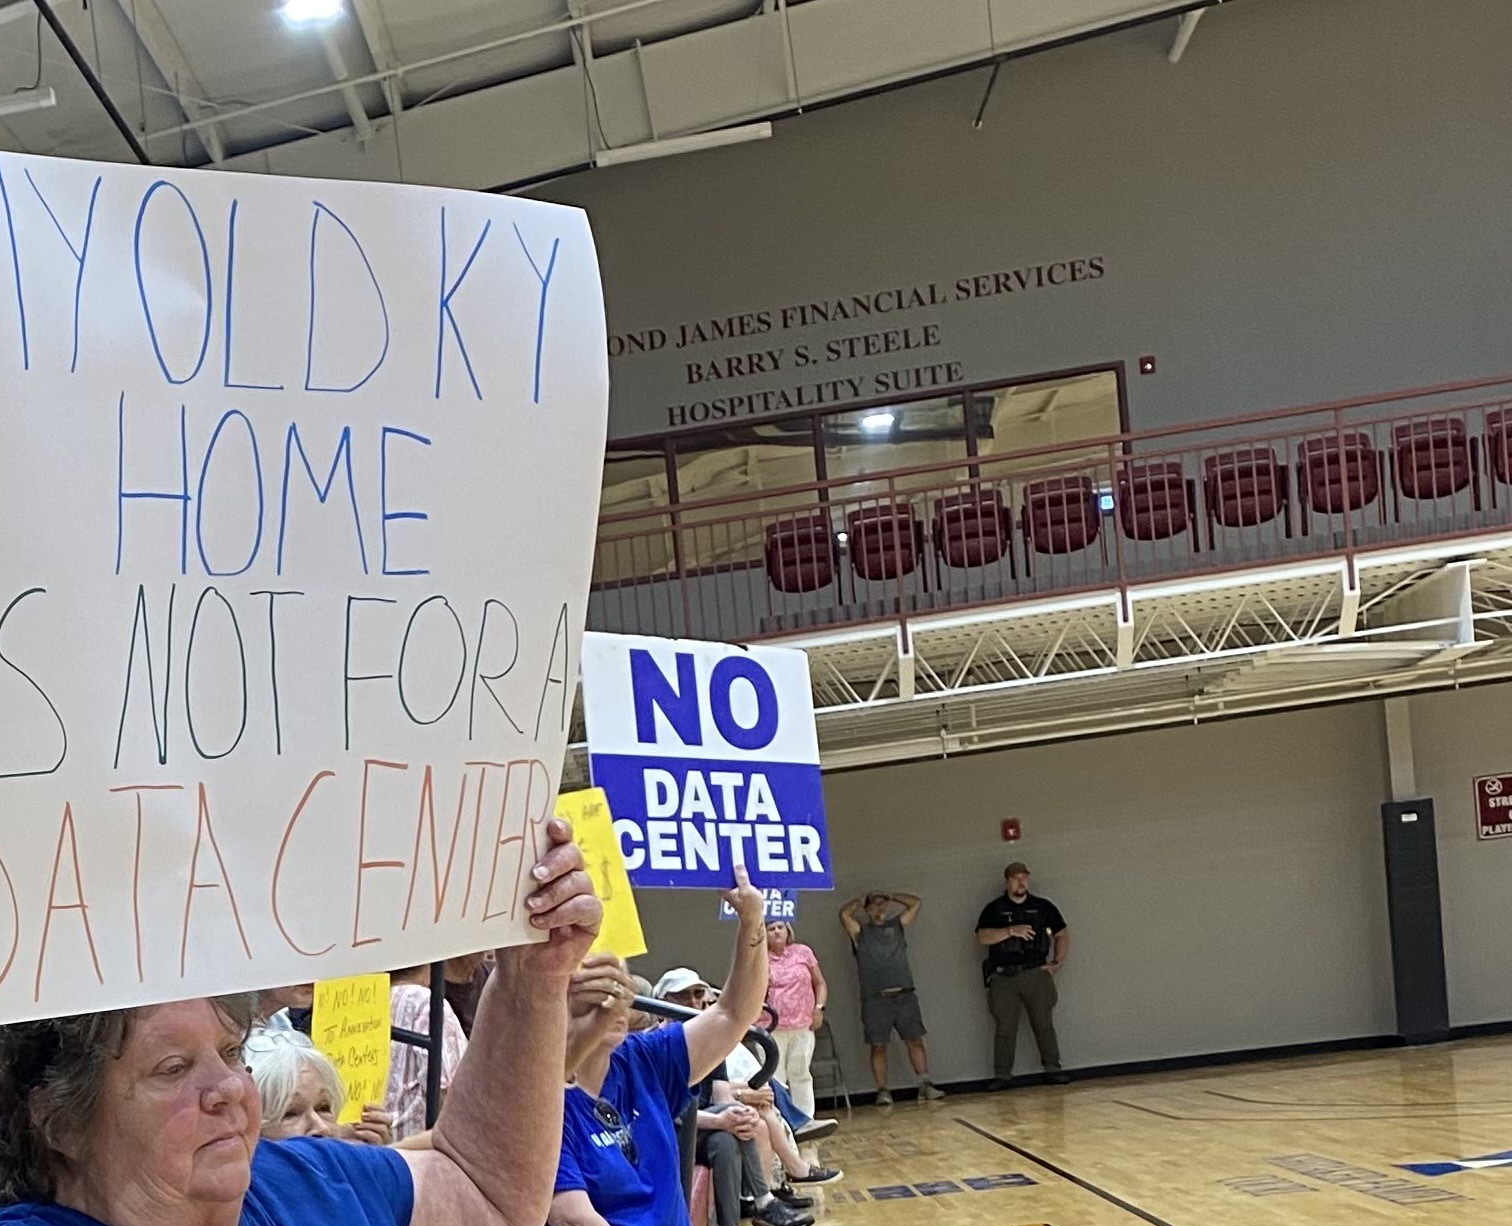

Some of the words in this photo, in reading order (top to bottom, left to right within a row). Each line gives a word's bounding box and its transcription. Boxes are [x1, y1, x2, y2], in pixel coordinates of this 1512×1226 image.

[134, 180, 389, 392] OLD
[434, 206, 559, 403] KY
[676, 310, 773, 349] JAMES
[780, 283, 948, 330] FINANCIAL
[955, 256, 1105, 301] SERVICES
[666, 376, 866, 427] HOSPITALITY
[874, 361, 964, 395] SUITE
[685, 349, 785, 385] BARRY
[794, 345, 818, 368] S.
[826, 323, 941, 363] STEELE
[115, 390, 431, 576] HOME
[113, 583, 305, 769] NOT
[343, 595, 525, 751] FOR
[534, 601, 569, 742] A
[629, 648, 779, 750] NO
[643, 768, 781, 822] DATA
[271, 758, 552, 957] CENTER
[614, 819, 825, 873] CENTER
